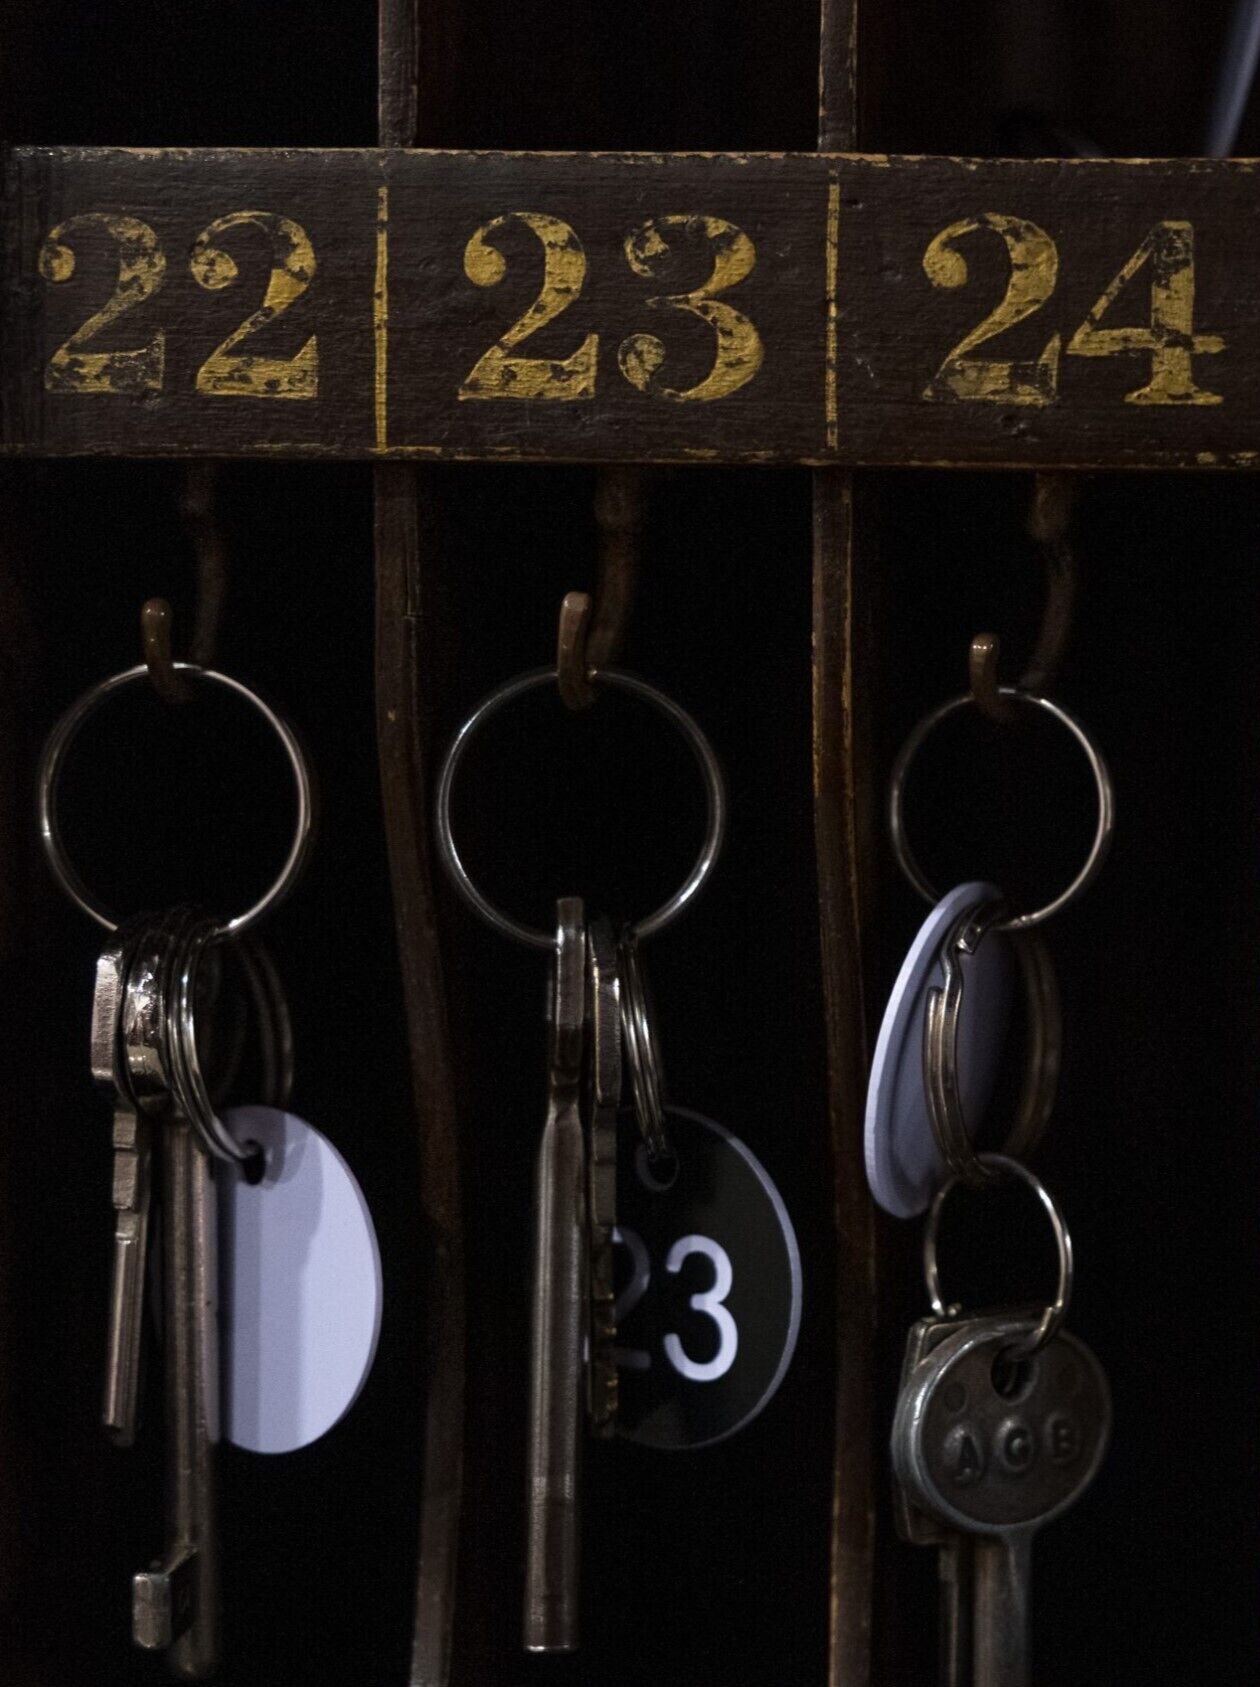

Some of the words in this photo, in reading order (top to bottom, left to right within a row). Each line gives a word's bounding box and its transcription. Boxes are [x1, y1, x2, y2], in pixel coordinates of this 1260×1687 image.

[39, 211, 319, 397] 22
[458, 211, 764, 401] 23
[921, 212, 1226, 406] 24
